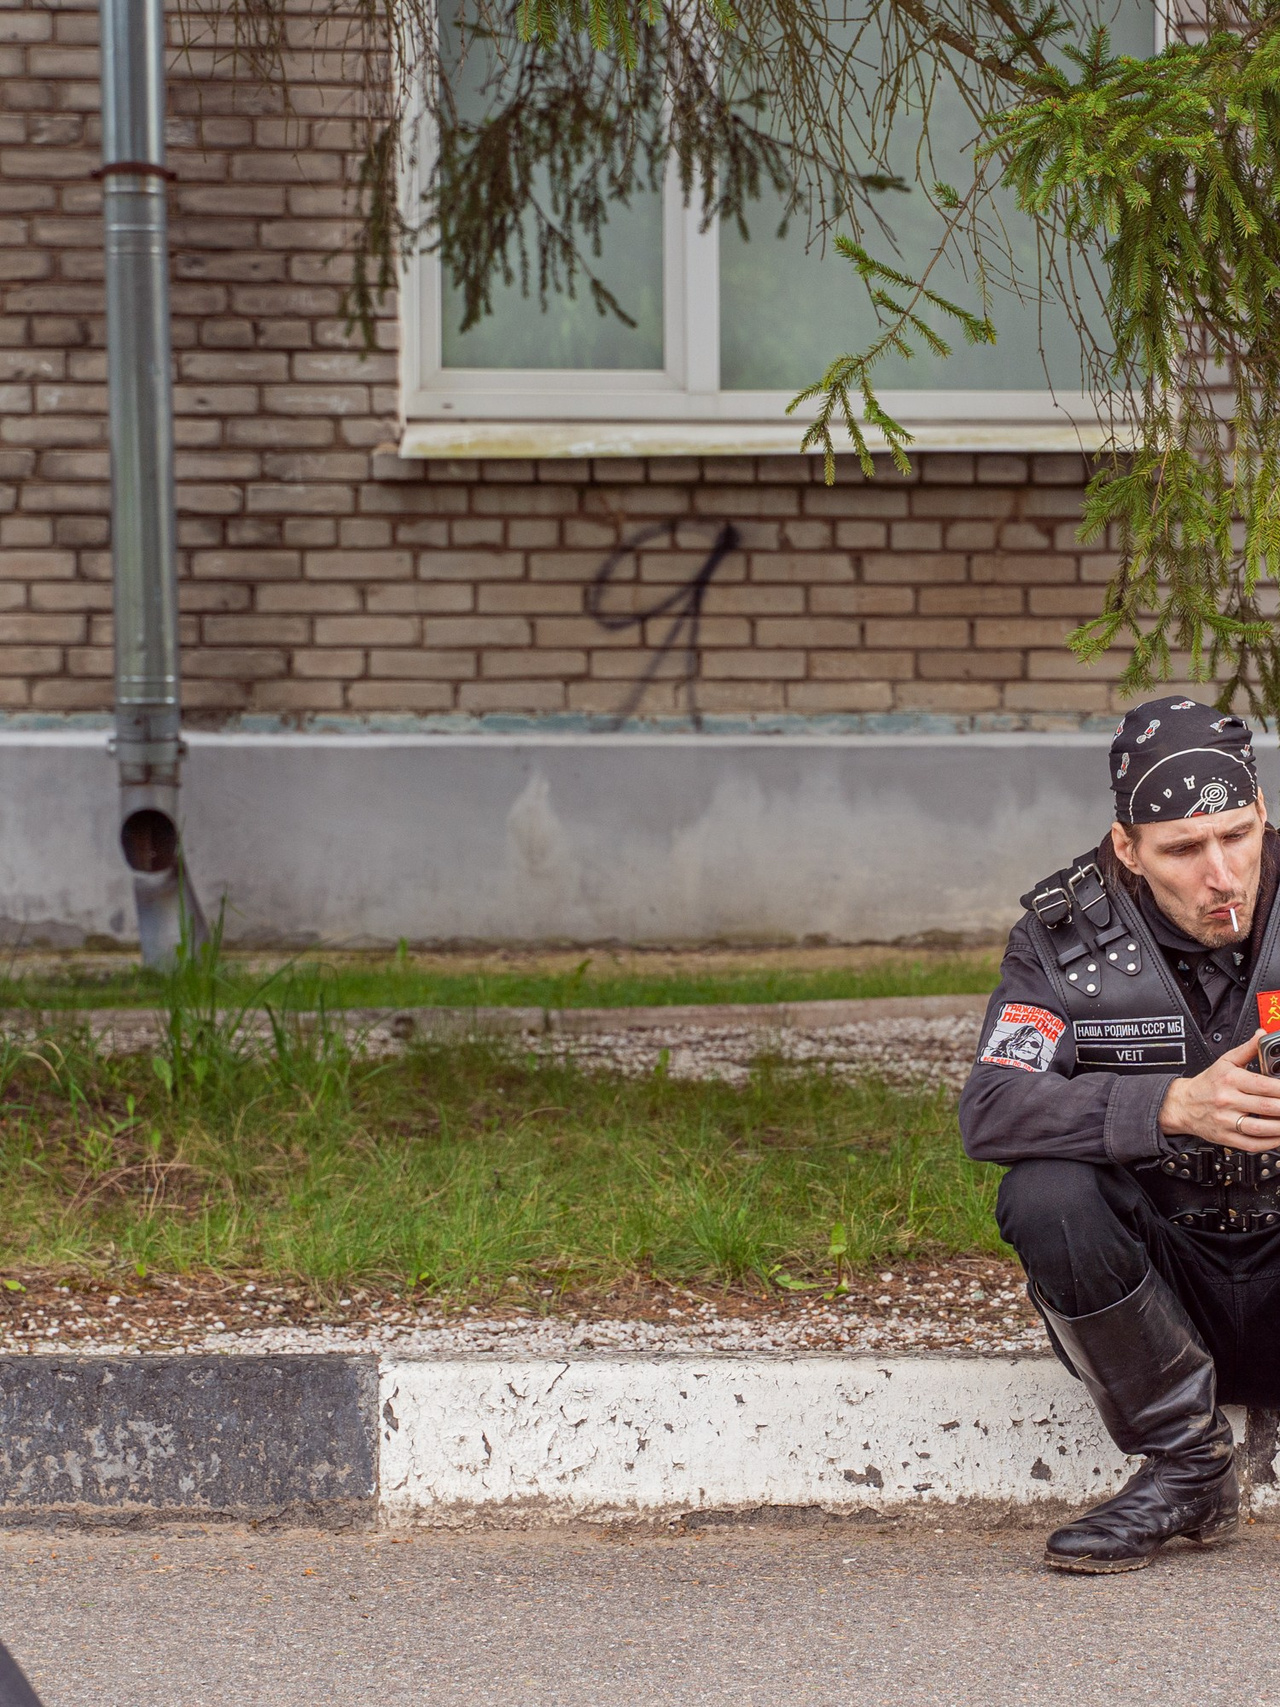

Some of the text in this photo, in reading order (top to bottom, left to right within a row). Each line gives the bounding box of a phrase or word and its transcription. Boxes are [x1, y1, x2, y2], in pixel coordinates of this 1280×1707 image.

[1005, 1004, 1066, 1032] ГРАЖДАНСКАЯ
[1078, 1021, 1181, 1037] НАША РОДИНА СССР МБ
[1116, 1050, 1144, 1061] VEIT
